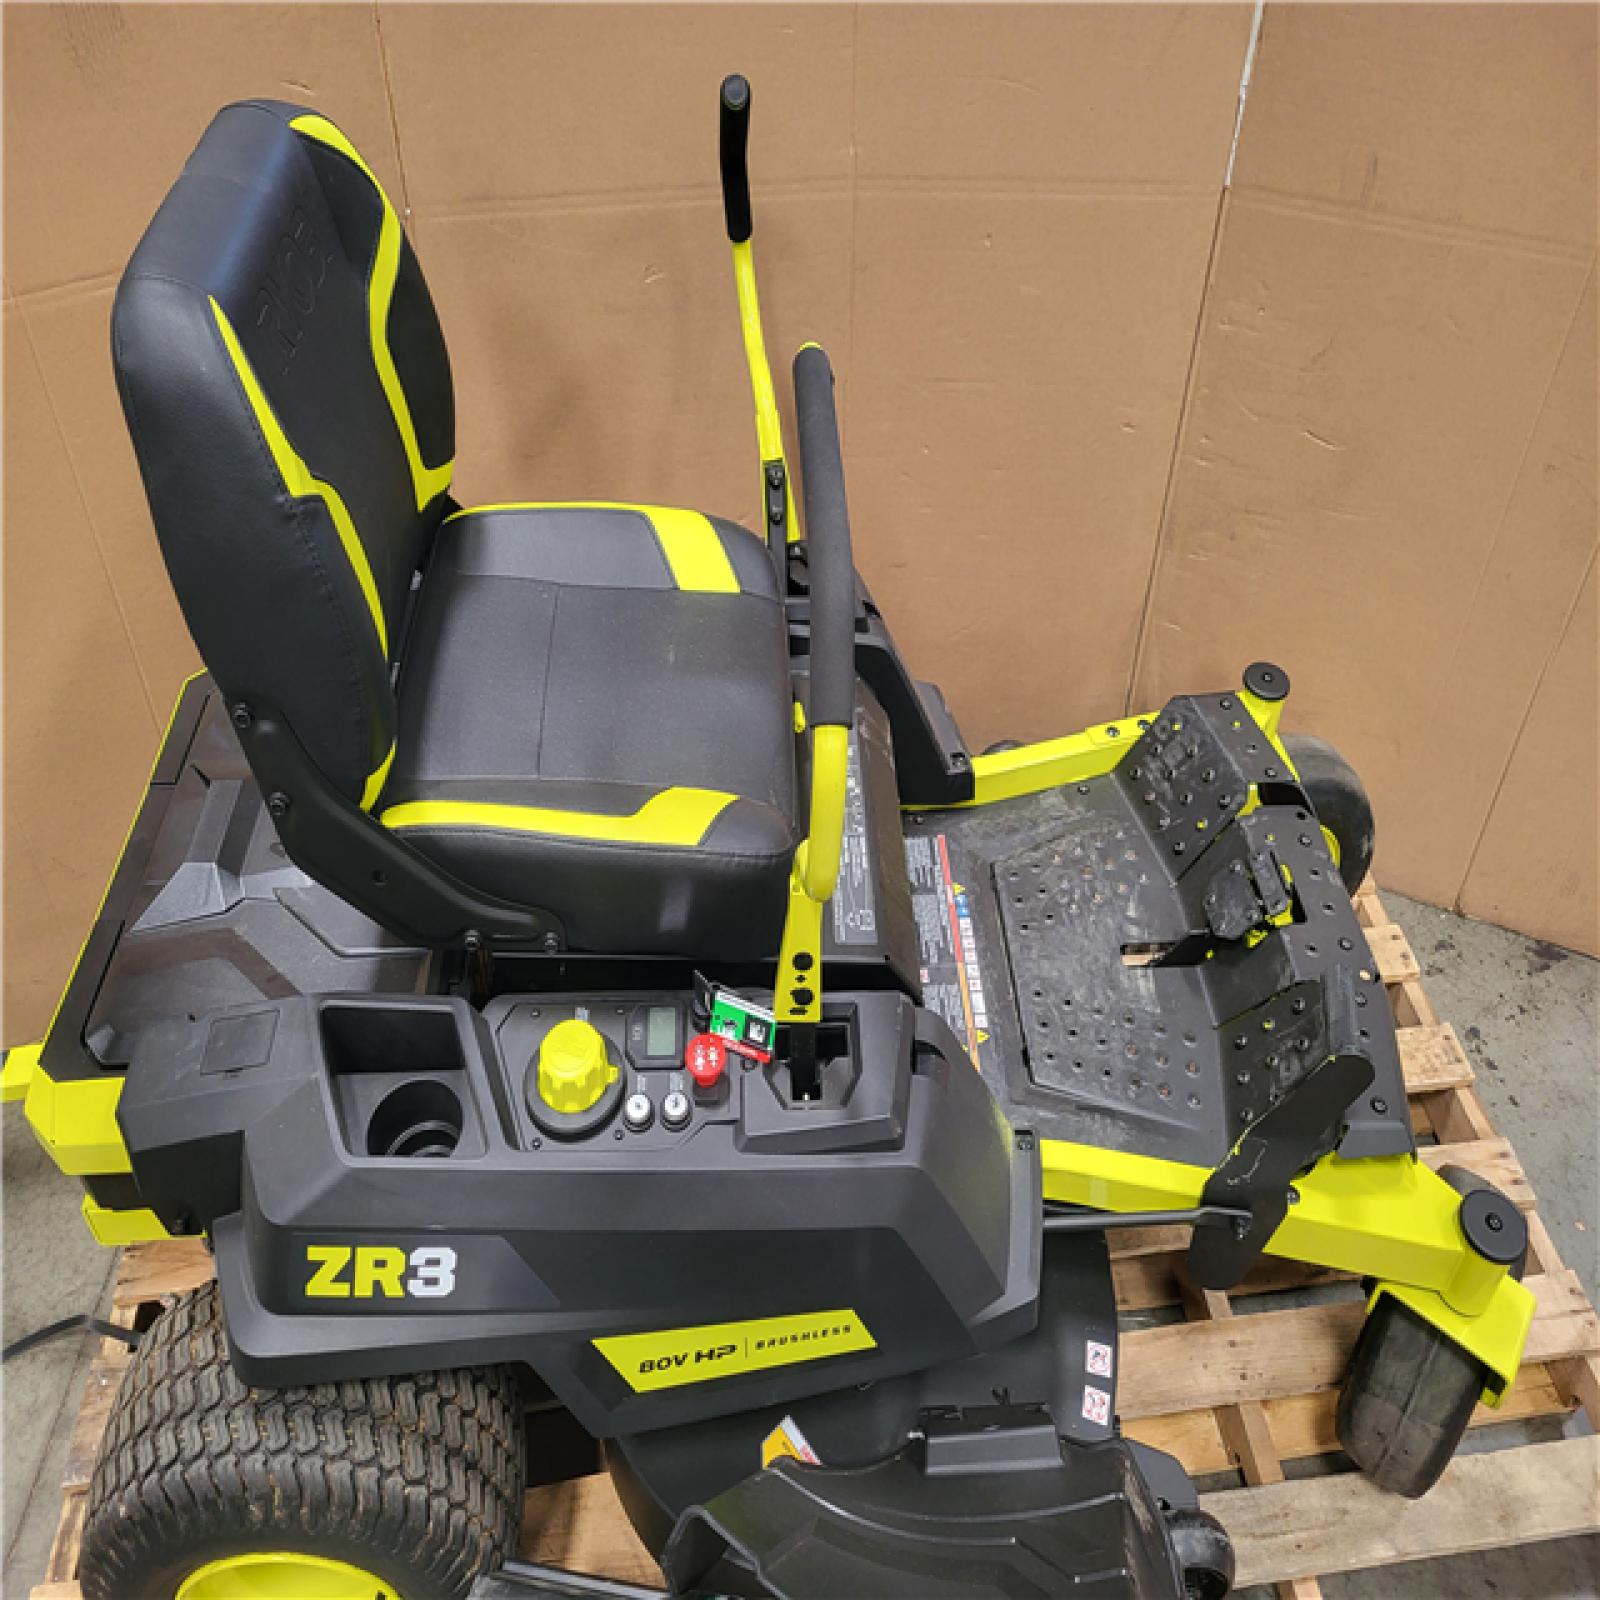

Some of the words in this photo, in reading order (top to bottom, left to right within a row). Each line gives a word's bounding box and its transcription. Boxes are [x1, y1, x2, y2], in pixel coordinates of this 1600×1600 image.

[305, 1245, 457, 1297] ZR3
[639, 1352, 688, 1373] 80V
[694, 1344, 738, 1363] HP
[755, 1324, 851, 1350] BRUSHLESS
